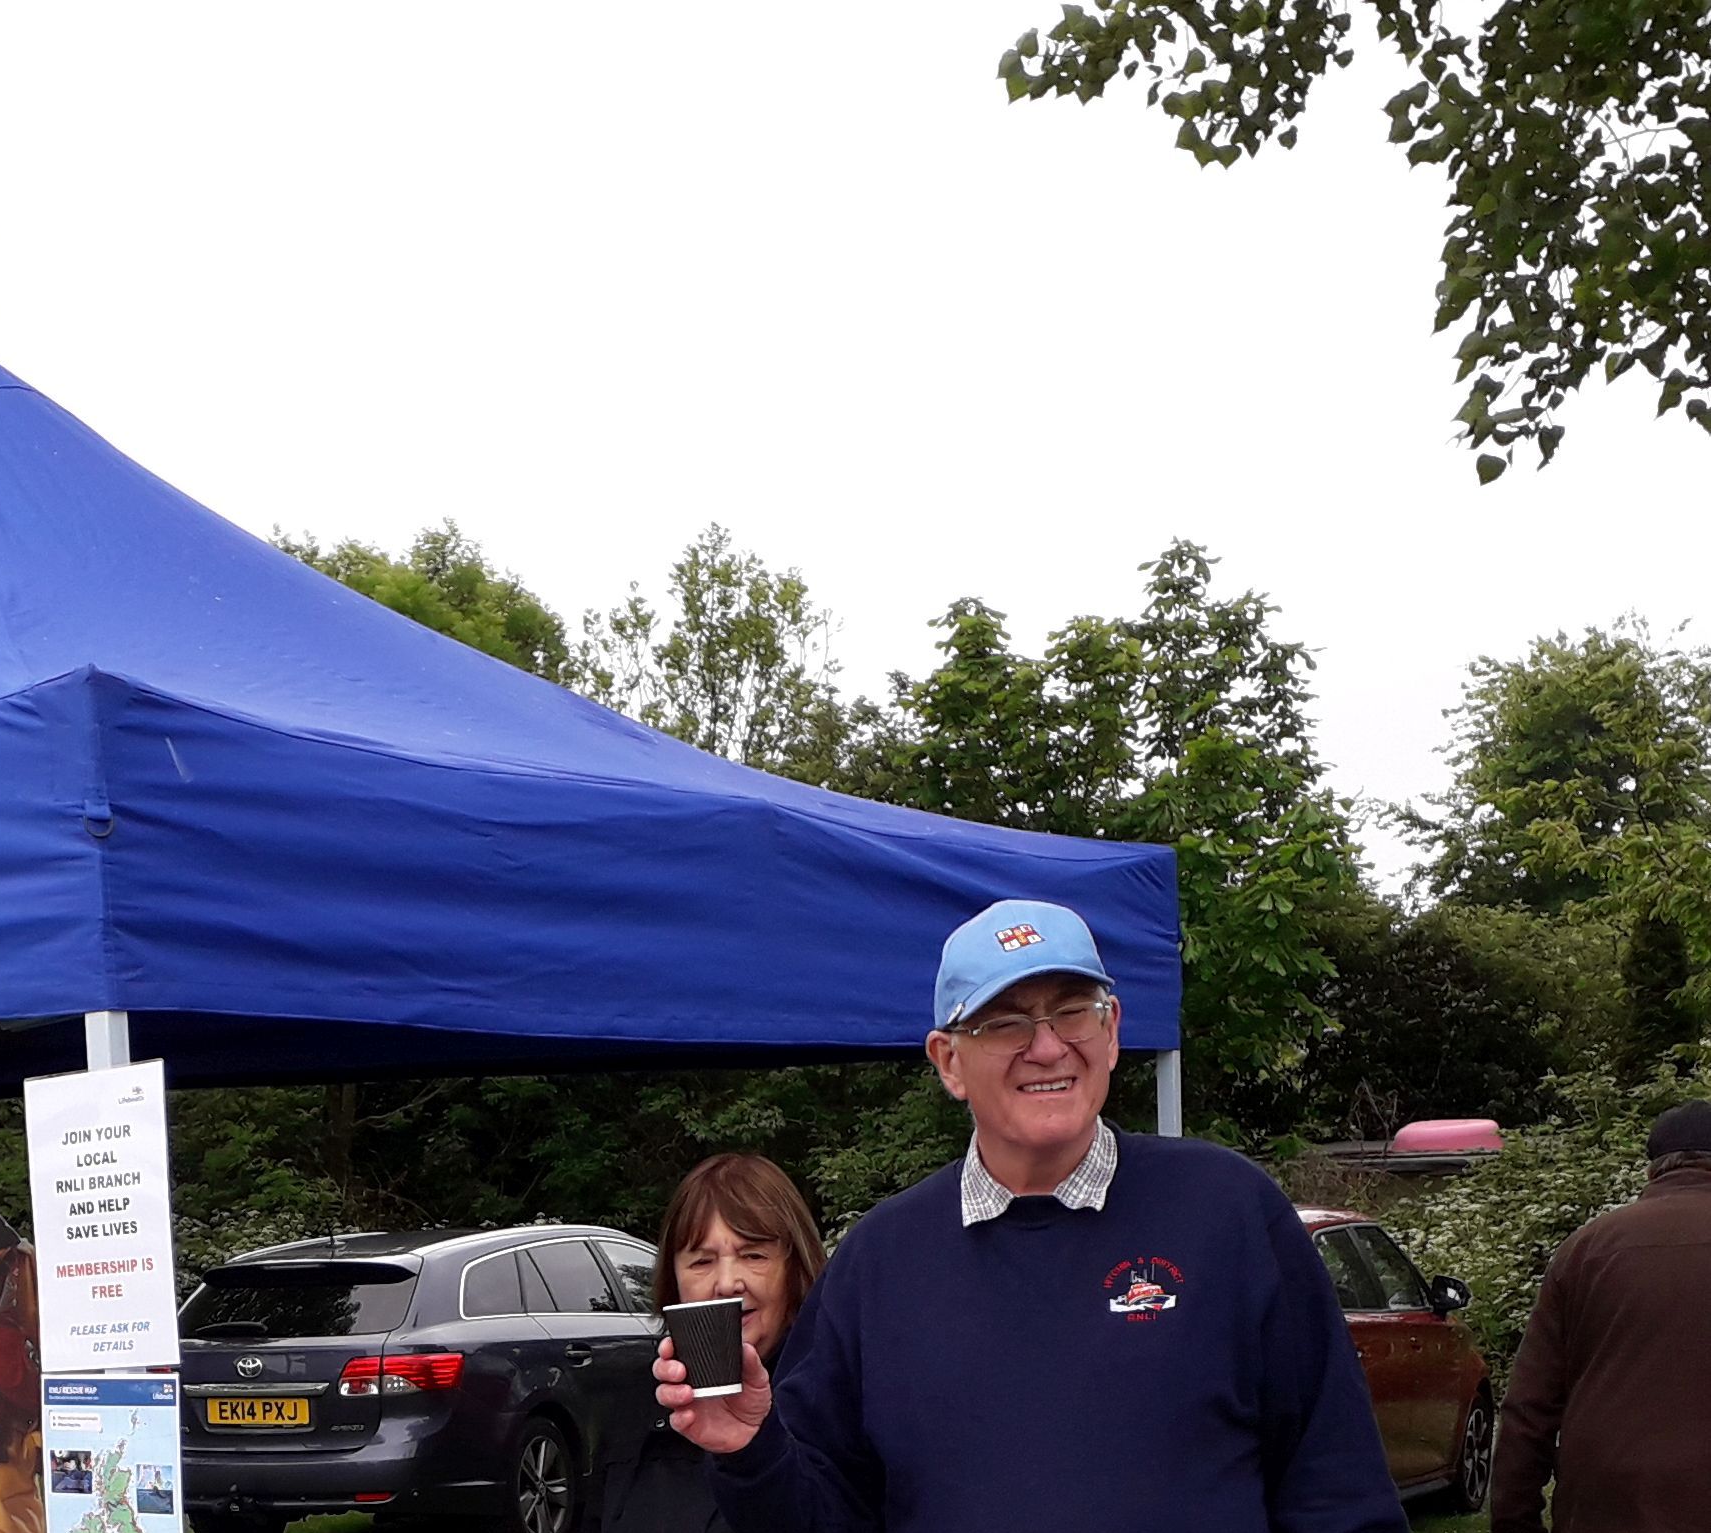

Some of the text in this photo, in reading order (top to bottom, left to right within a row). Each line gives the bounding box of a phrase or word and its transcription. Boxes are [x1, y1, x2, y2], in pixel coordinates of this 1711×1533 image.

[62, 1125, 131, 1145] JOIN YOUR
[76, 1151, 117, 1167] LOCAL
[56, 1172, 141, 1194] RNLI BRANCH
[69, 1198, 130, 1216] AND HELP
[66, 1221, 138, 1240] SAVE LIVES
[56, 1258, 154, 1278] MEMBERSHIP IS
[92, 1283, 123, 1299] FREE
[70, 1320, 150, 1336] PLEASE ASK FOR
[93, 1339, 134, 1352] DETAILS
[219, 1401, 298, 1421] EK14 PXJ
